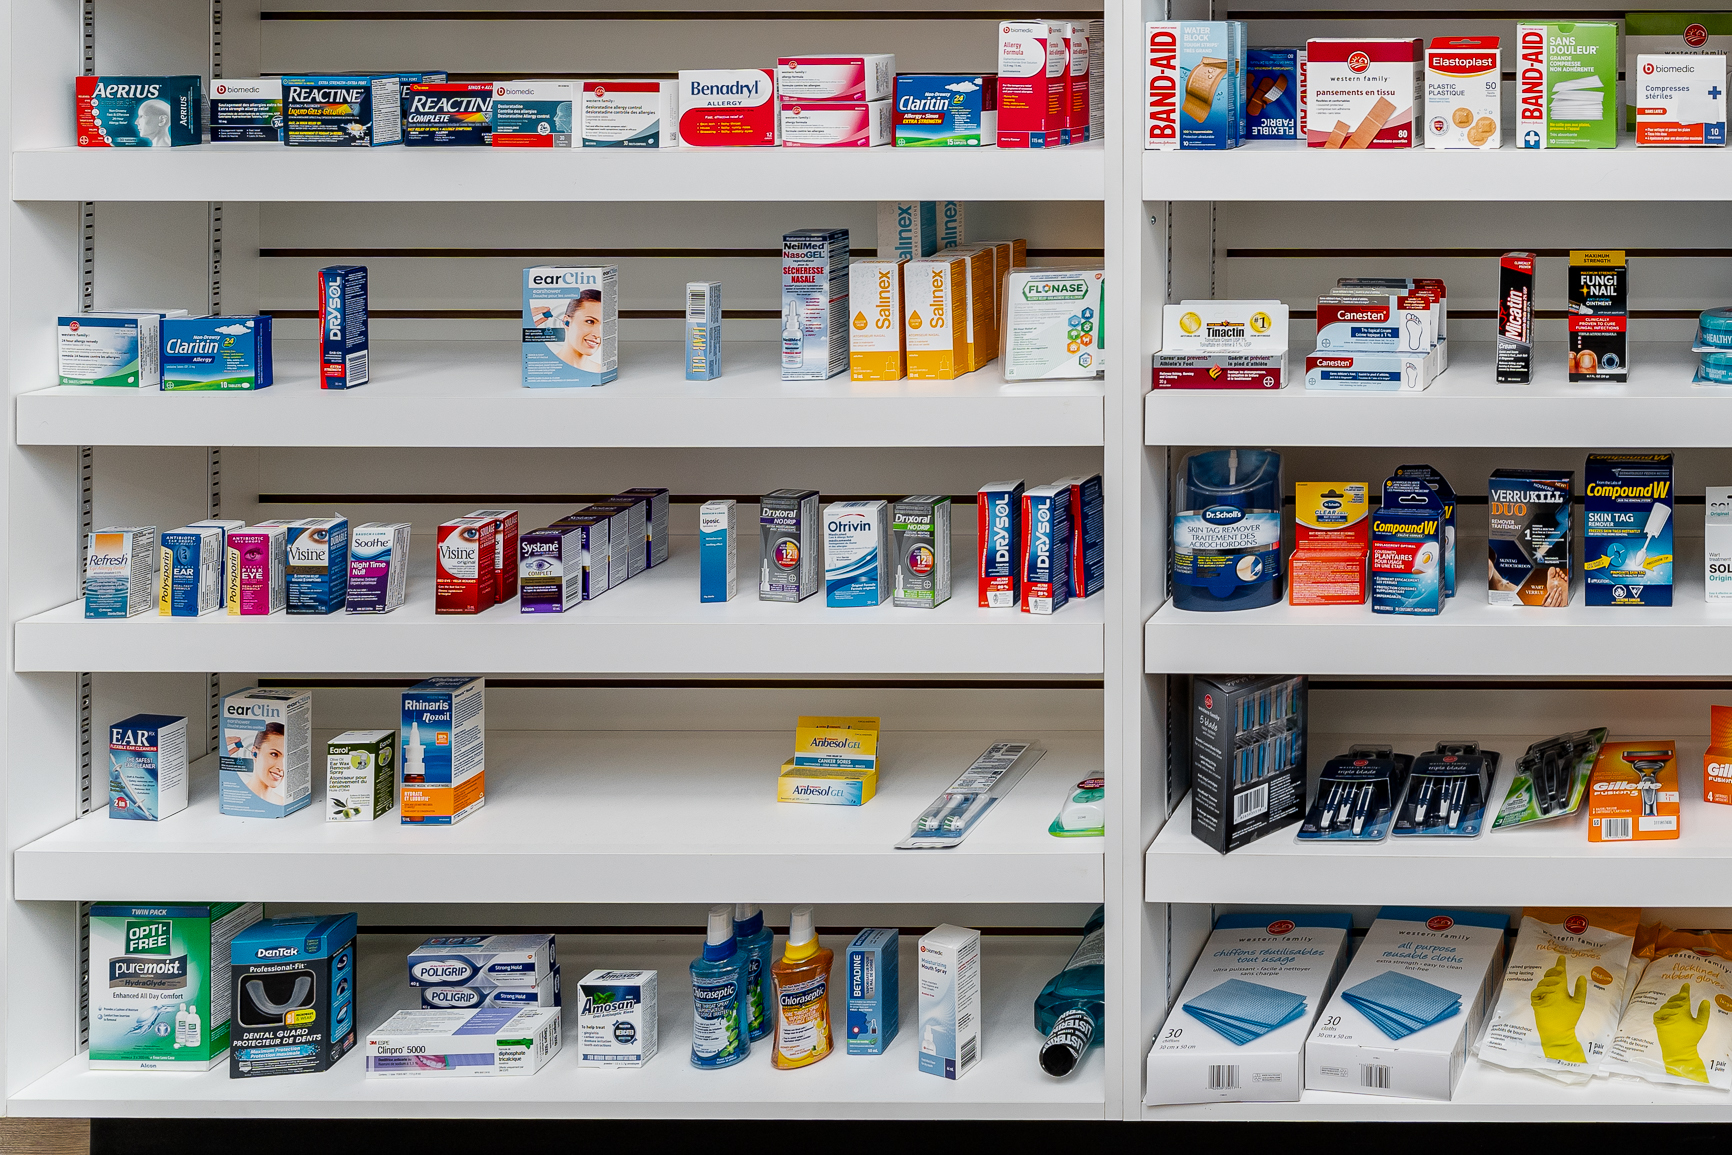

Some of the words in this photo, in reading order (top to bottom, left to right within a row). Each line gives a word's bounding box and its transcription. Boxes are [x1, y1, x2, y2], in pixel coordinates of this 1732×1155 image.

[1433, 56, 1492, 68] Elastoplast
[691, 80, 758, 98] Benadryl
[1150, 31, 1176, 139] BAND-AID
[288, 87, 362, 103] REACTINE
[1316, 89, 1363, 99] pansements
[1377, 88, 1395, 96] tissu
[784, 242, 824, 251] NeilMed
[783, 266, 824, 275] SÉCHERESSE
[533, 272, 596, 285] earClin
[791, 275, 815, 284] NASALE
[1581, 275, 1616, 285] FUNGI
[1590, 286, 1616, 296] NAIL
[1337, 310, 1385, 321] Canesten
[1207, 327, 1244, 337] Tinactin
[166, 339, 218, 354] Claritin
[1492, 490, 1563, 503] VERRUKILL
[1492, 503, 1526, 515] DUO
[828, 520, 871, 533] Otrivin
[996, 494, 1009, 562] DRYSOL
[354, 538, 388, 549] Soothe
[90, 554, 127, 567] Refresh
[129, 925, 167, 939] OPTI-
[130, 936, 168, 950] FREE
[1401, 943, 1411, 951] all
[1416, 944, 1456, 954] purpose
[257, 948, 299, 957] DenTek
[1382, 950, 1425, 960] reusable
[1429, 954, 1462, 963] cloths
[250, 964, 304, 972] Professional-Fit
[421, 966, 468, 977] POLIGRIP
[852, 954, 863, 997] BETADINE
[149, 993, 161, 1001] Day
[581, 998, 635, 1014] Amosan
[1324, 1016, 1340, 1025] 30
[243, 1032, 280, 1040] DENTAL
